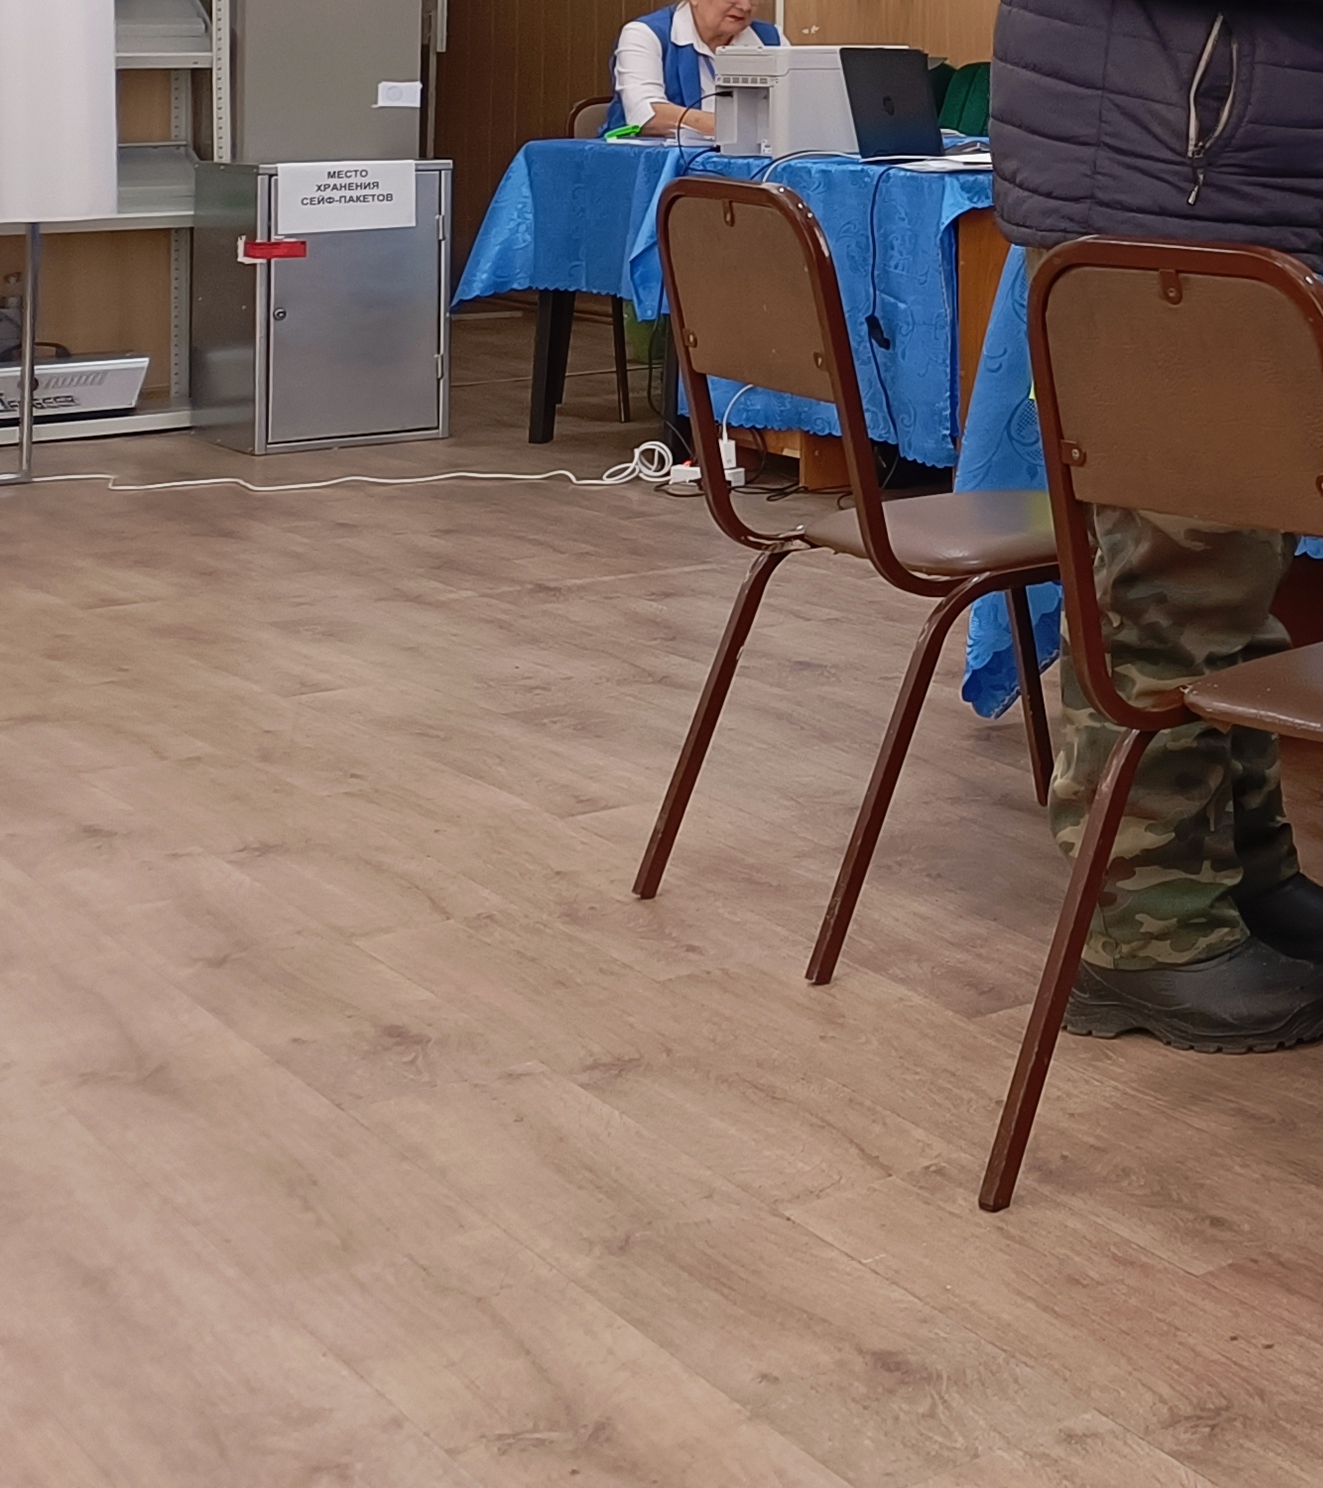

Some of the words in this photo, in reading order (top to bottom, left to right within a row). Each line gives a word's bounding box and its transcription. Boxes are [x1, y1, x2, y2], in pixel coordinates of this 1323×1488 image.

[327, 169, 369, 179] МЕСТО
[315, 181, 380, 192] ХРАНЕНИЯ
[301, 193, 394, 206] СЕЙФ-ПАКЕТОВ
